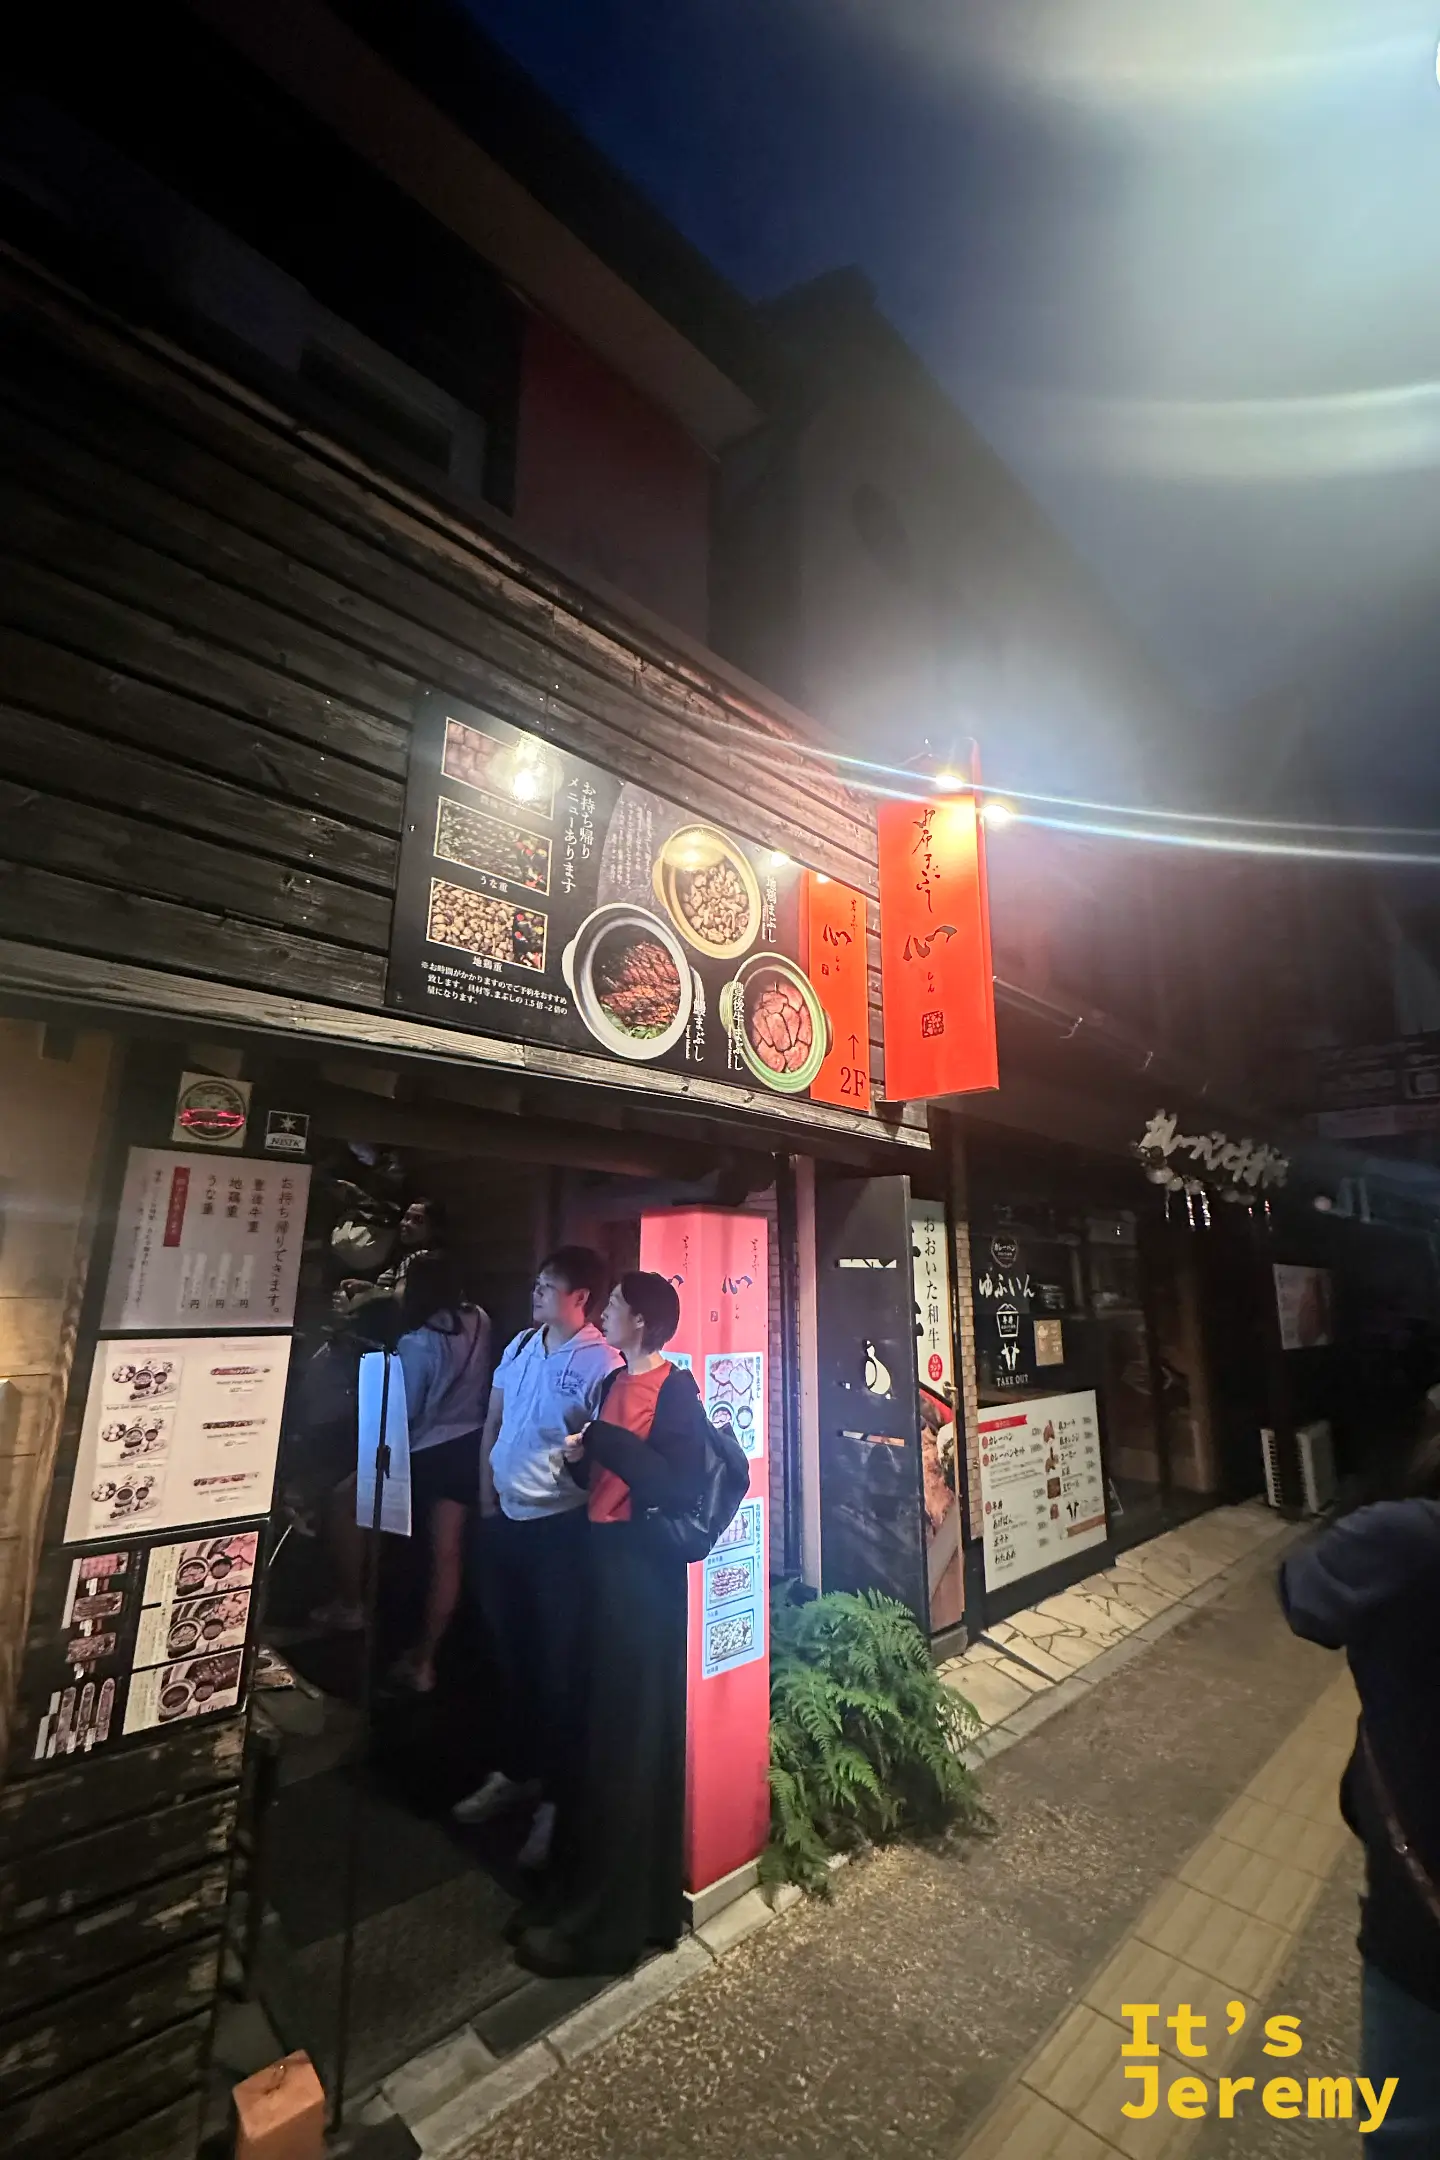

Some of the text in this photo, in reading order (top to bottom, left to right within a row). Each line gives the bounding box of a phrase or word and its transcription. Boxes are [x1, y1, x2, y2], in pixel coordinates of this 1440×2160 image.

[578, 781, 597, 859] お持ち帰り
[561, 777, 579, 894] メニューあります
[479, 874, 509, 893] うな重
[823, 924, 853, 947] 心
[903, 925, 958, 962] 心
[472, 956, 503, 973] 地鶏重
[427, 985, 478, 1005] 量になります。
[840, 1066, 866, 1098] 2F
[201, 1175, 217, 1215] うな重
[721, 1275, 753, 1295] 心
[923, 1217, 940, 1349] おおいた和牛
[979, 1273, 1035, 1298] ゆふいん
[996, 1374, 1028, 1387] TAKE OUT
